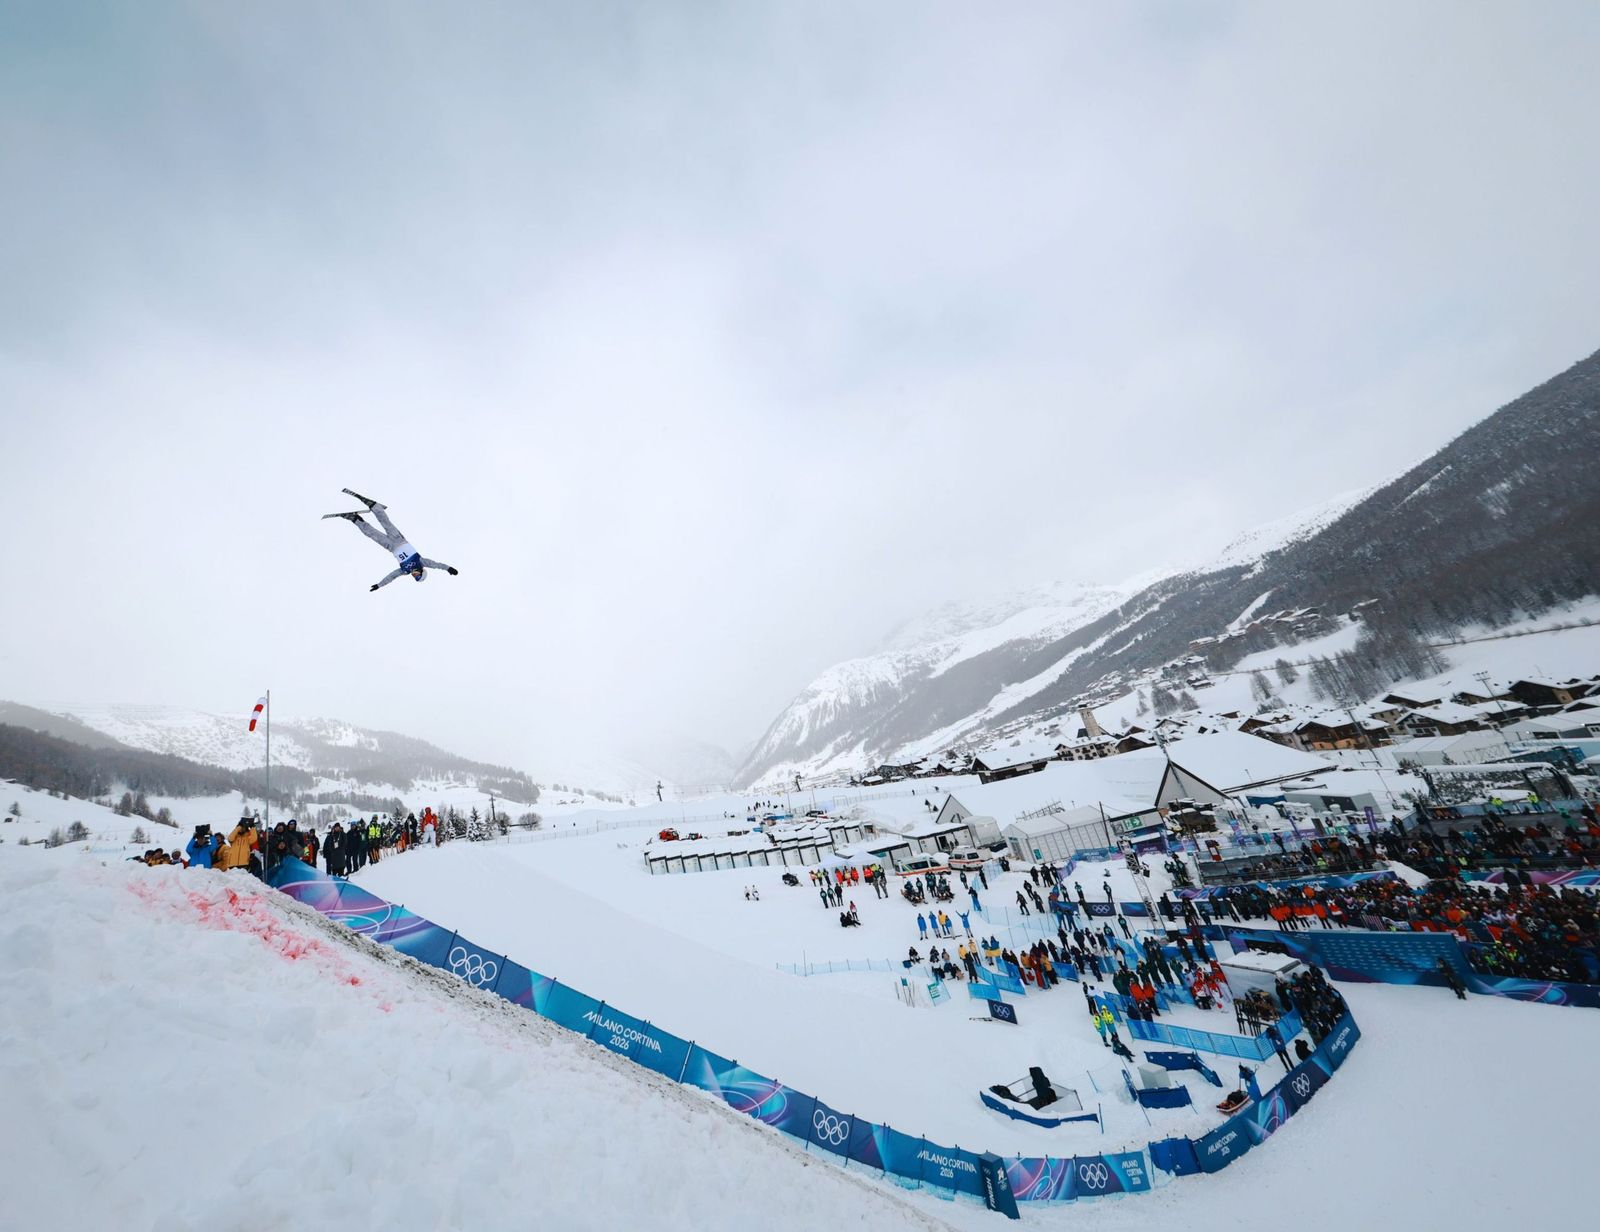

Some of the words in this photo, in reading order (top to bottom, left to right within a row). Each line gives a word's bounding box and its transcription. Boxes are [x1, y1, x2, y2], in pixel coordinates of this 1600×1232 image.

[398, 551, 408, 561] 15
[582, 1011, 624, 1035] MILANO
[623, 1028, 662, 1053] CORTINA
[609, 1034, 630, 1050] 2026
[917, 1150, 947, 1166] MILANO
[948, 1158, 977, 1174] CORTINA
[940, 1167, 954, 1179] 2026
[985, 1176, 996, 1209] FINISH
